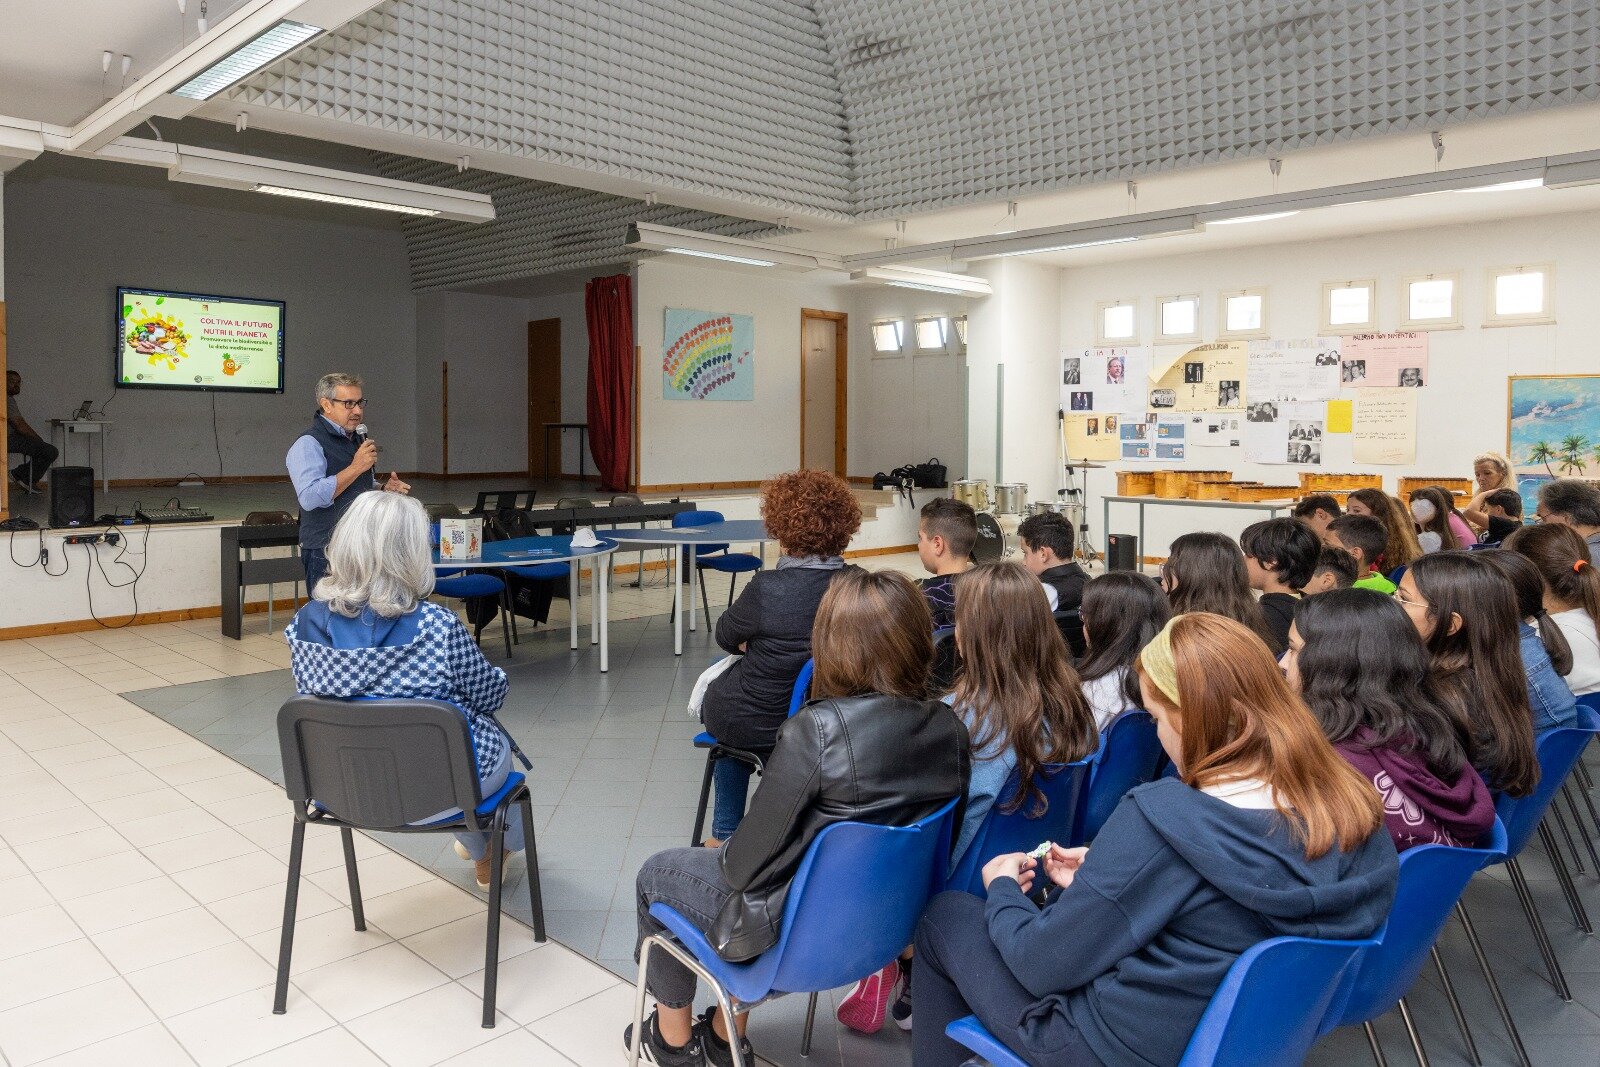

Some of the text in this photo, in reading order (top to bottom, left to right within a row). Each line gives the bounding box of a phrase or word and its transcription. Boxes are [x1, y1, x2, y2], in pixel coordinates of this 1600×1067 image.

[200, 318, 233, 326] COLTIVA
[242, 321, 273, 329] FUTURO
[203, 328, 227, 336] NUTRI
